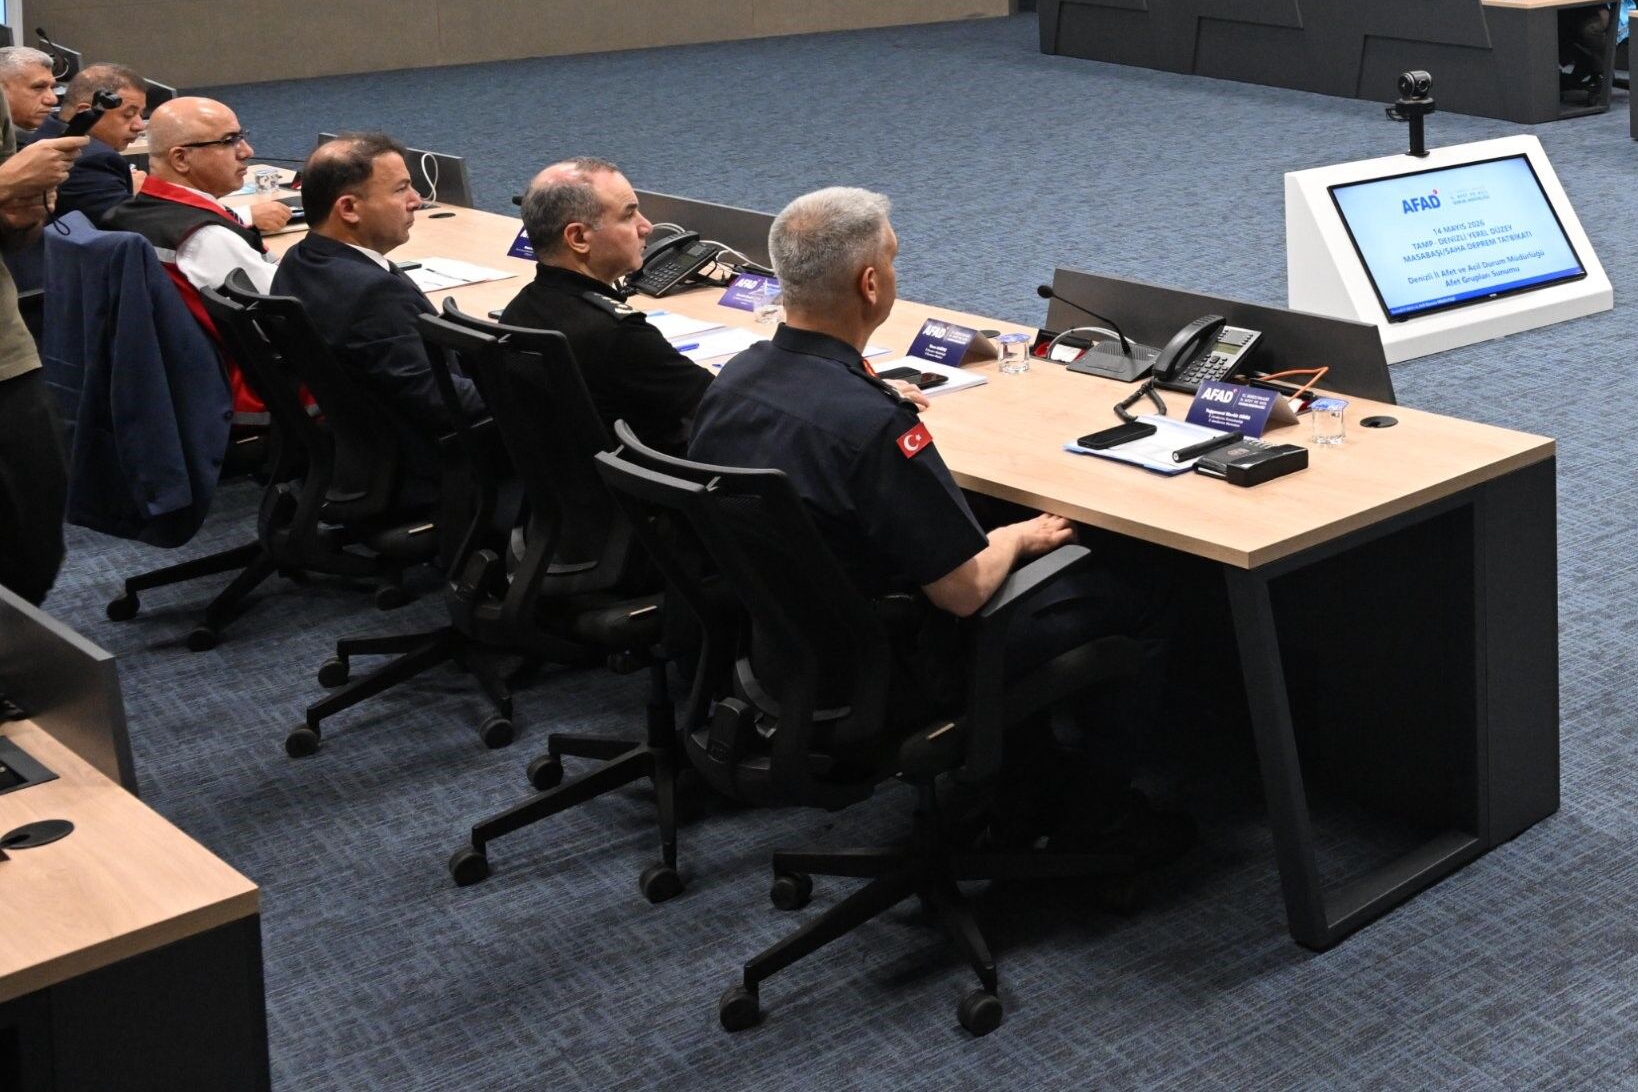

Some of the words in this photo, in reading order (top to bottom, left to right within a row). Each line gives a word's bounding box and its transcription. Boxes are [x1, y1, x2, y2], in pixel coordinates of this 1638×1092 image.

[1402, 194, 1442, 215] AFAD
[1442, 222, 1467, 233] MAYIS
[1467, 219, 1486, 229] 2026
[1468, 229, 1489, 240] YEREL
[1466, 238, 1497, 250] DEPREM
[1441, 268, 1457, 278] Afet
[1467, 261, 1482, 272] Acil
[1481, 258, 1506, 269] Durum
[1445, 277, 1462, 288] Afet
[1491, 266, 1520, 278] Sunumu
[921, 323, 947, 339] AFAD
[1200, 387, 1234, 404] AFAD
